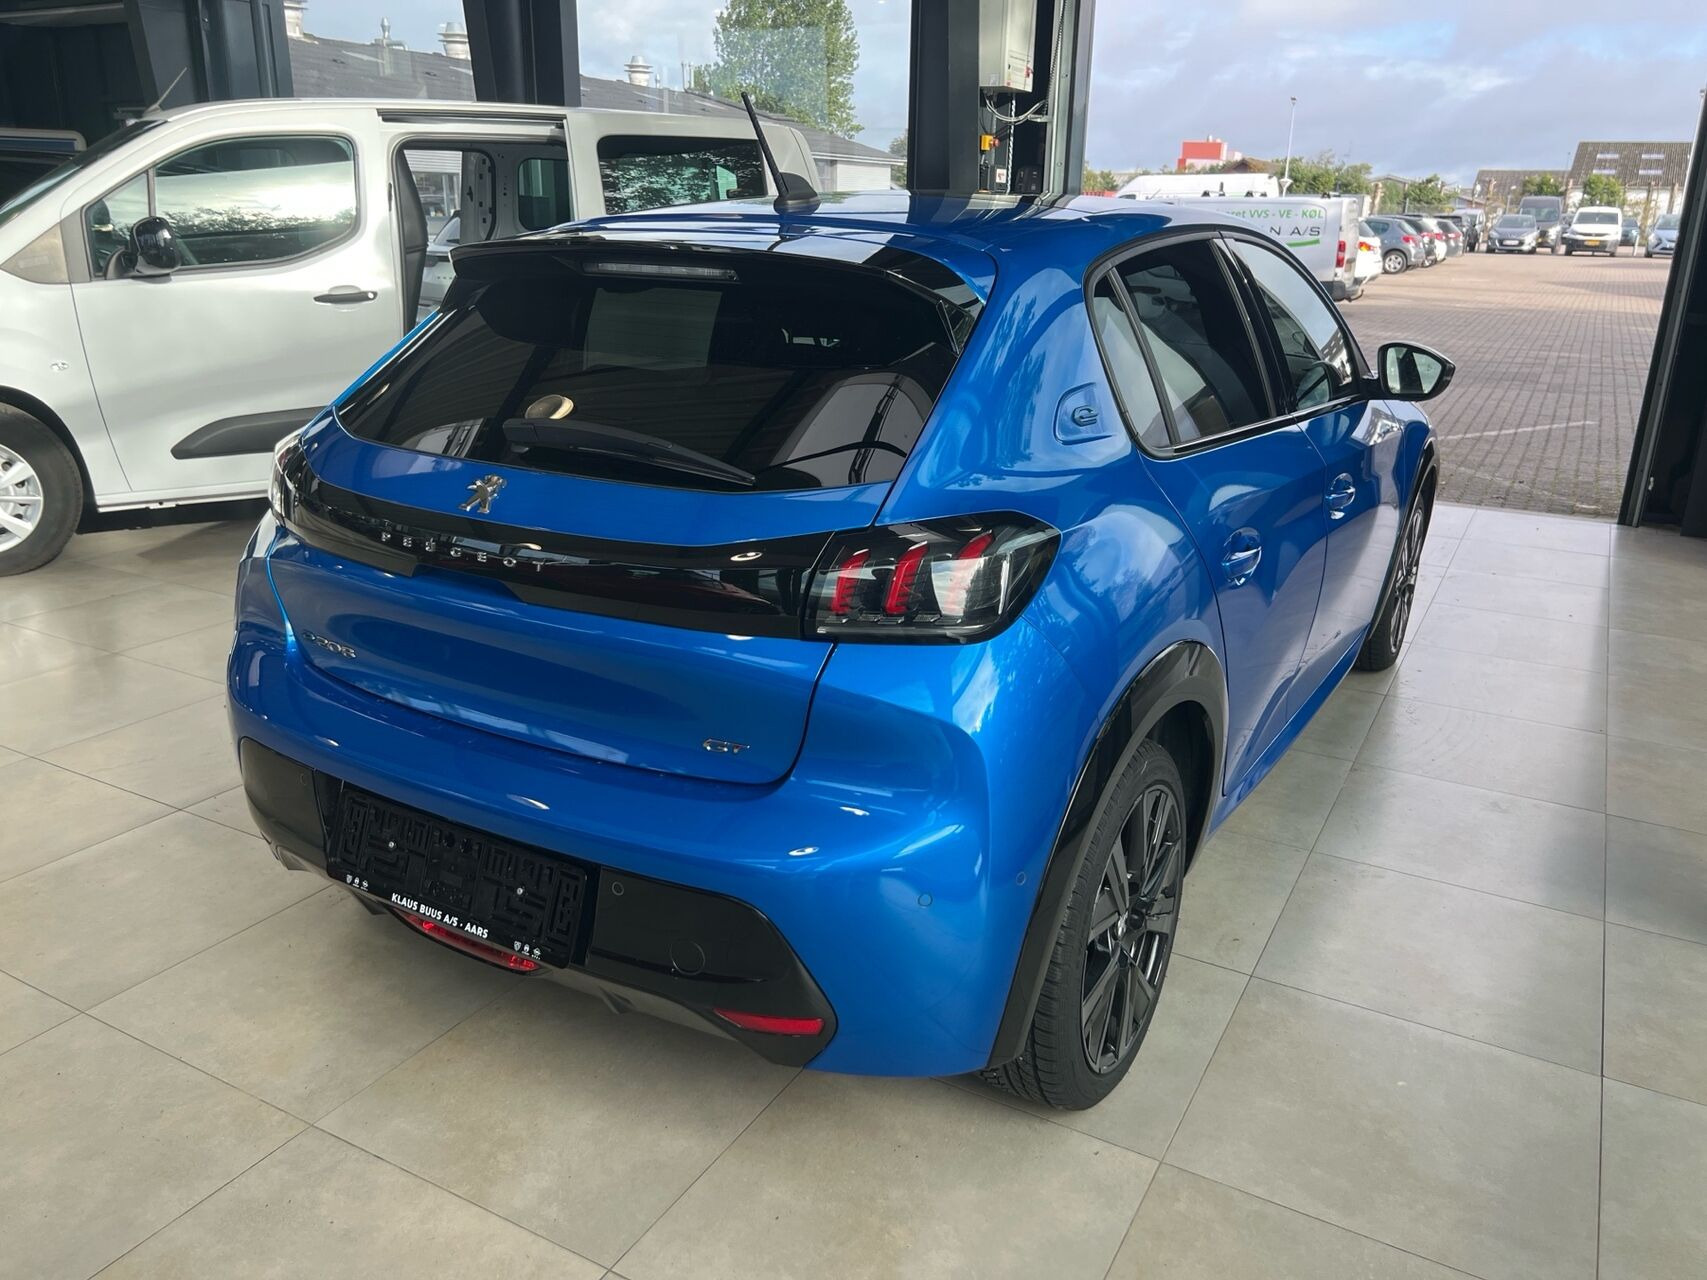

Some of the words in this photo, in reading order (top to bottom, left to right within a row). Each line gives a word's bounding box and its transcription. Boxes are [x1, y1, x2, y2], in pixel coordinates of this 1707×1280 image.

[1249, 209, 1270, 219] VVS
[1279, 209, 1292, 219] VE
[1301, 209, 1324, 219] KØL
[1290, 226, 1321, 237] A/S
[381, 531, 546, 572] PEUGEOT
[703, 738, 750, 754] GT
[391, 892, 418, 911] KLAUS
[419, 903, 443, 920] BUUS
[443, 913, 459, 927] A/S
[464, 922, 489, 939] AARS
